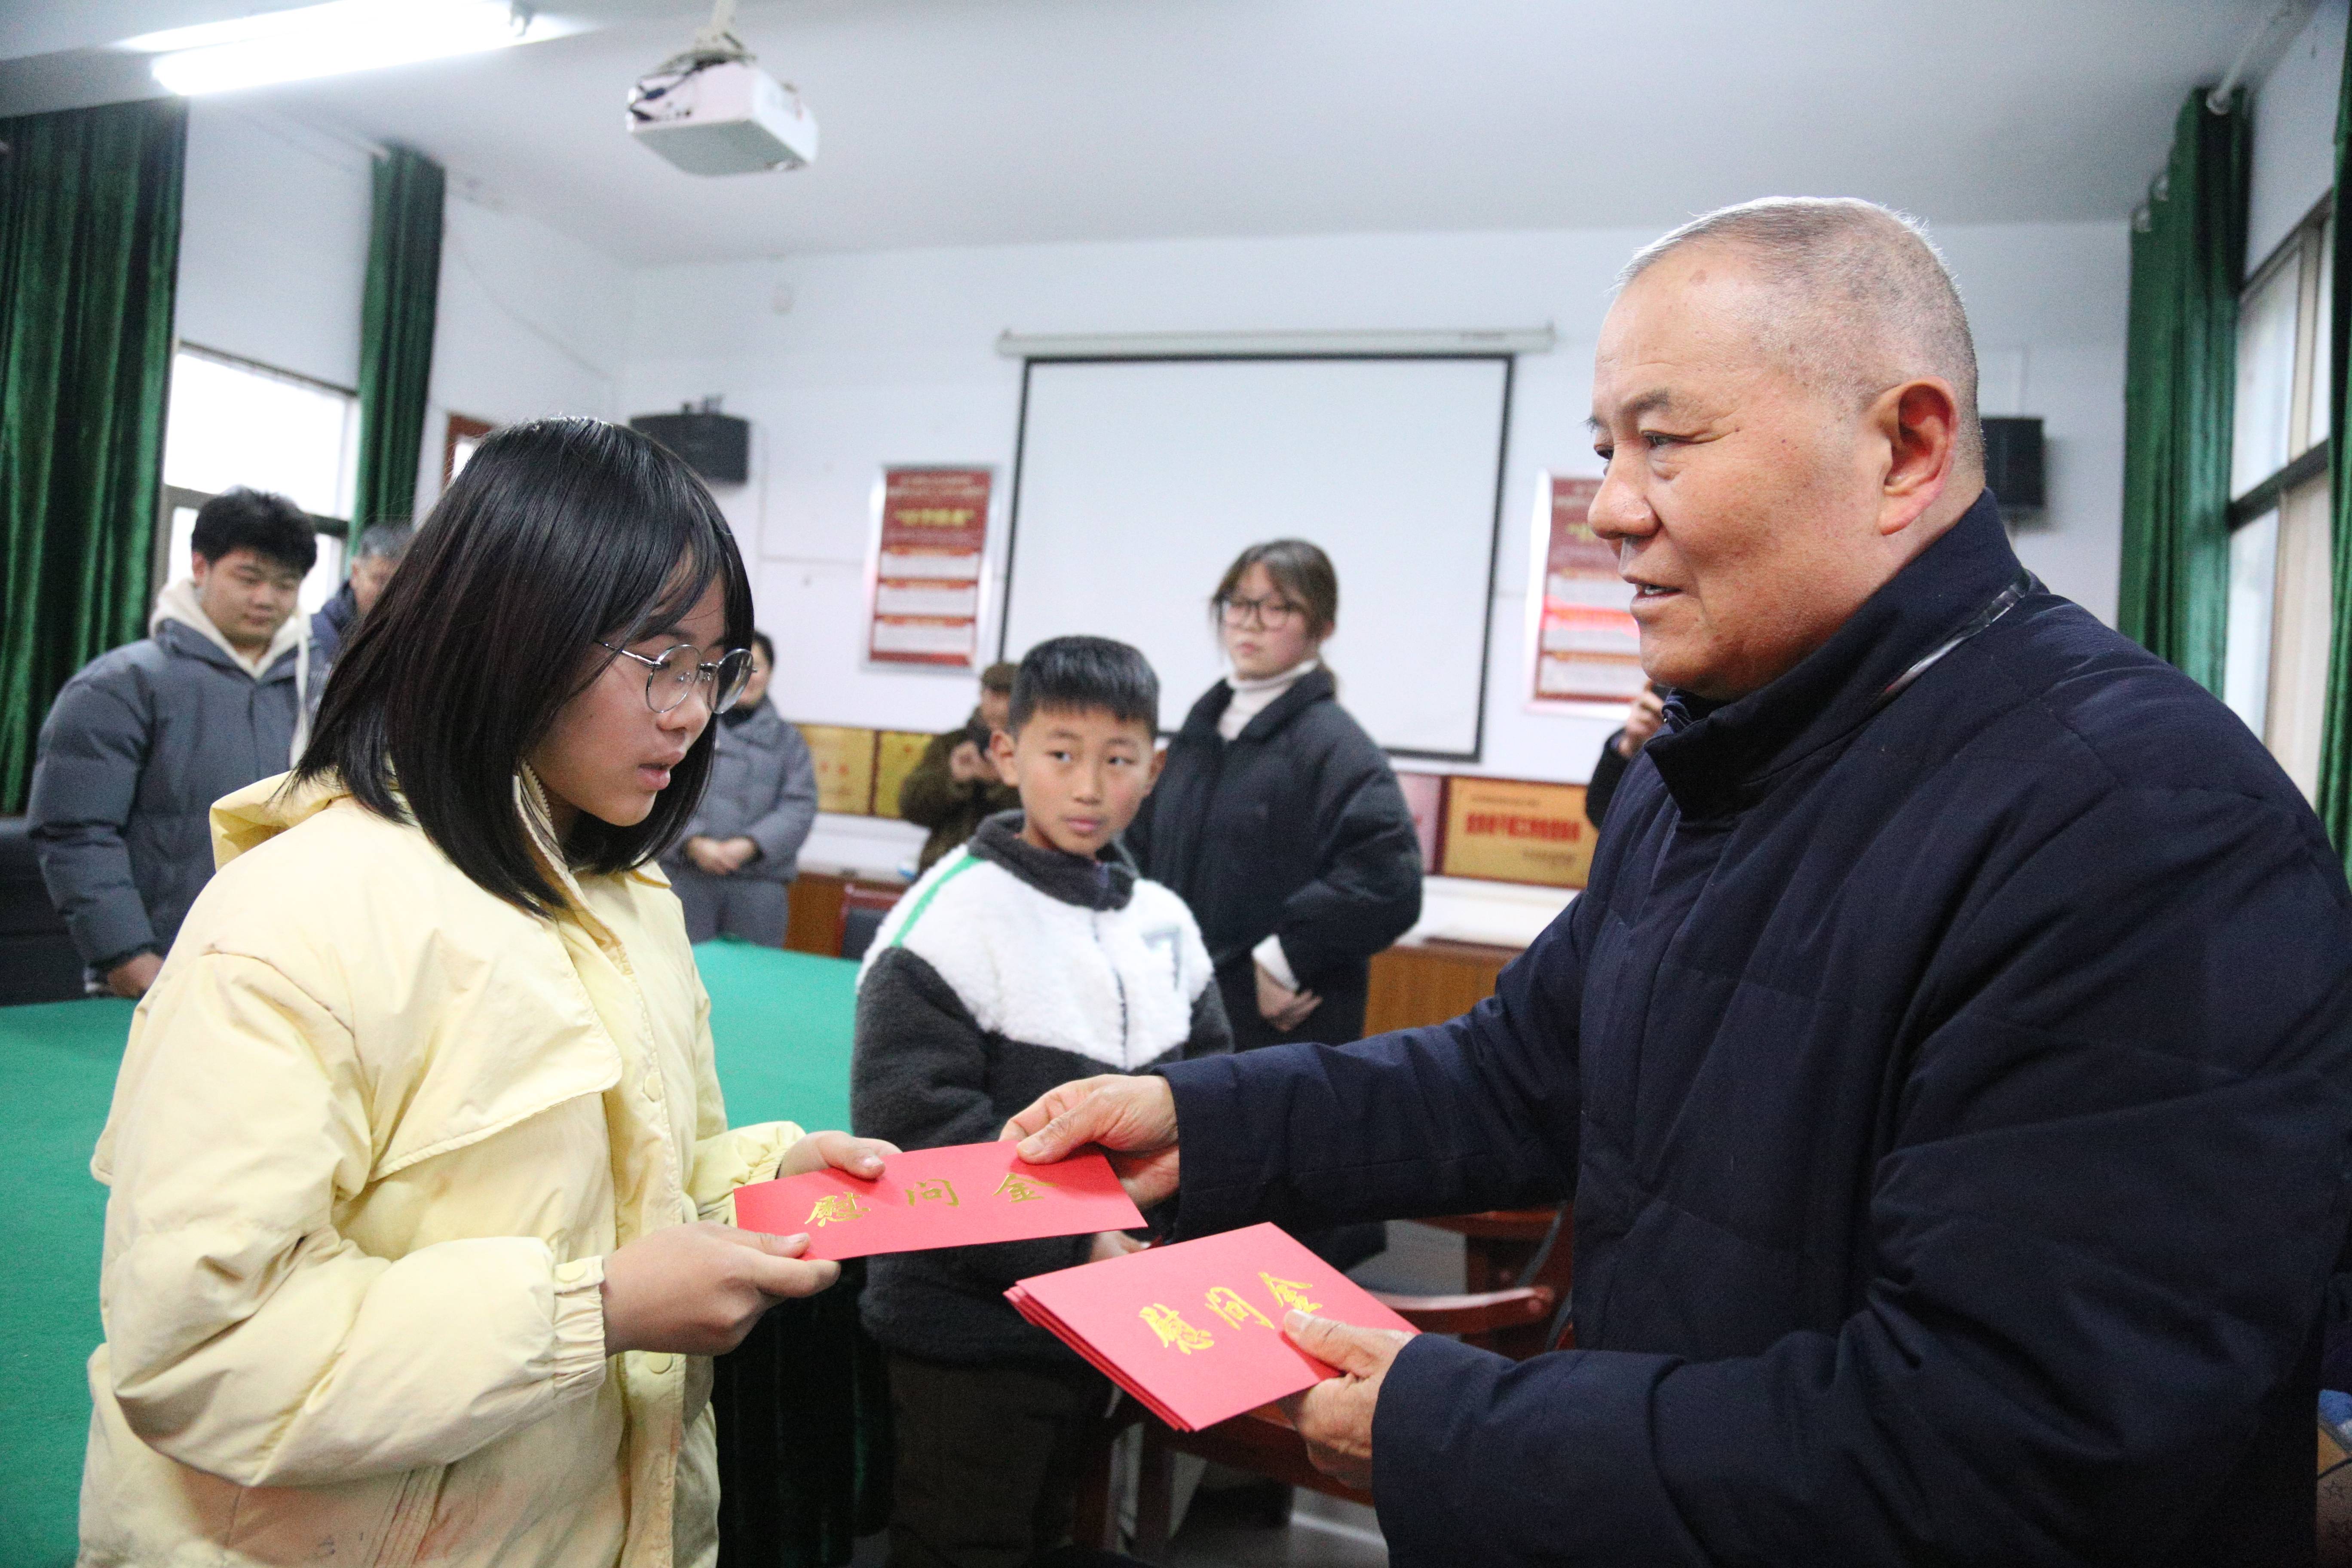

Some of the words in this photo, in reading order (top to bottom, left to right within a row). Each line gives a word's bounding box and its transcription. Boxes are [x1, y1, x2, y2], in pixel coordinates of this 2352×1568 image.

[805, 1173, 1057, 1228] 慰问金
[1139, 1272, 1323, 1355] 慰问金
